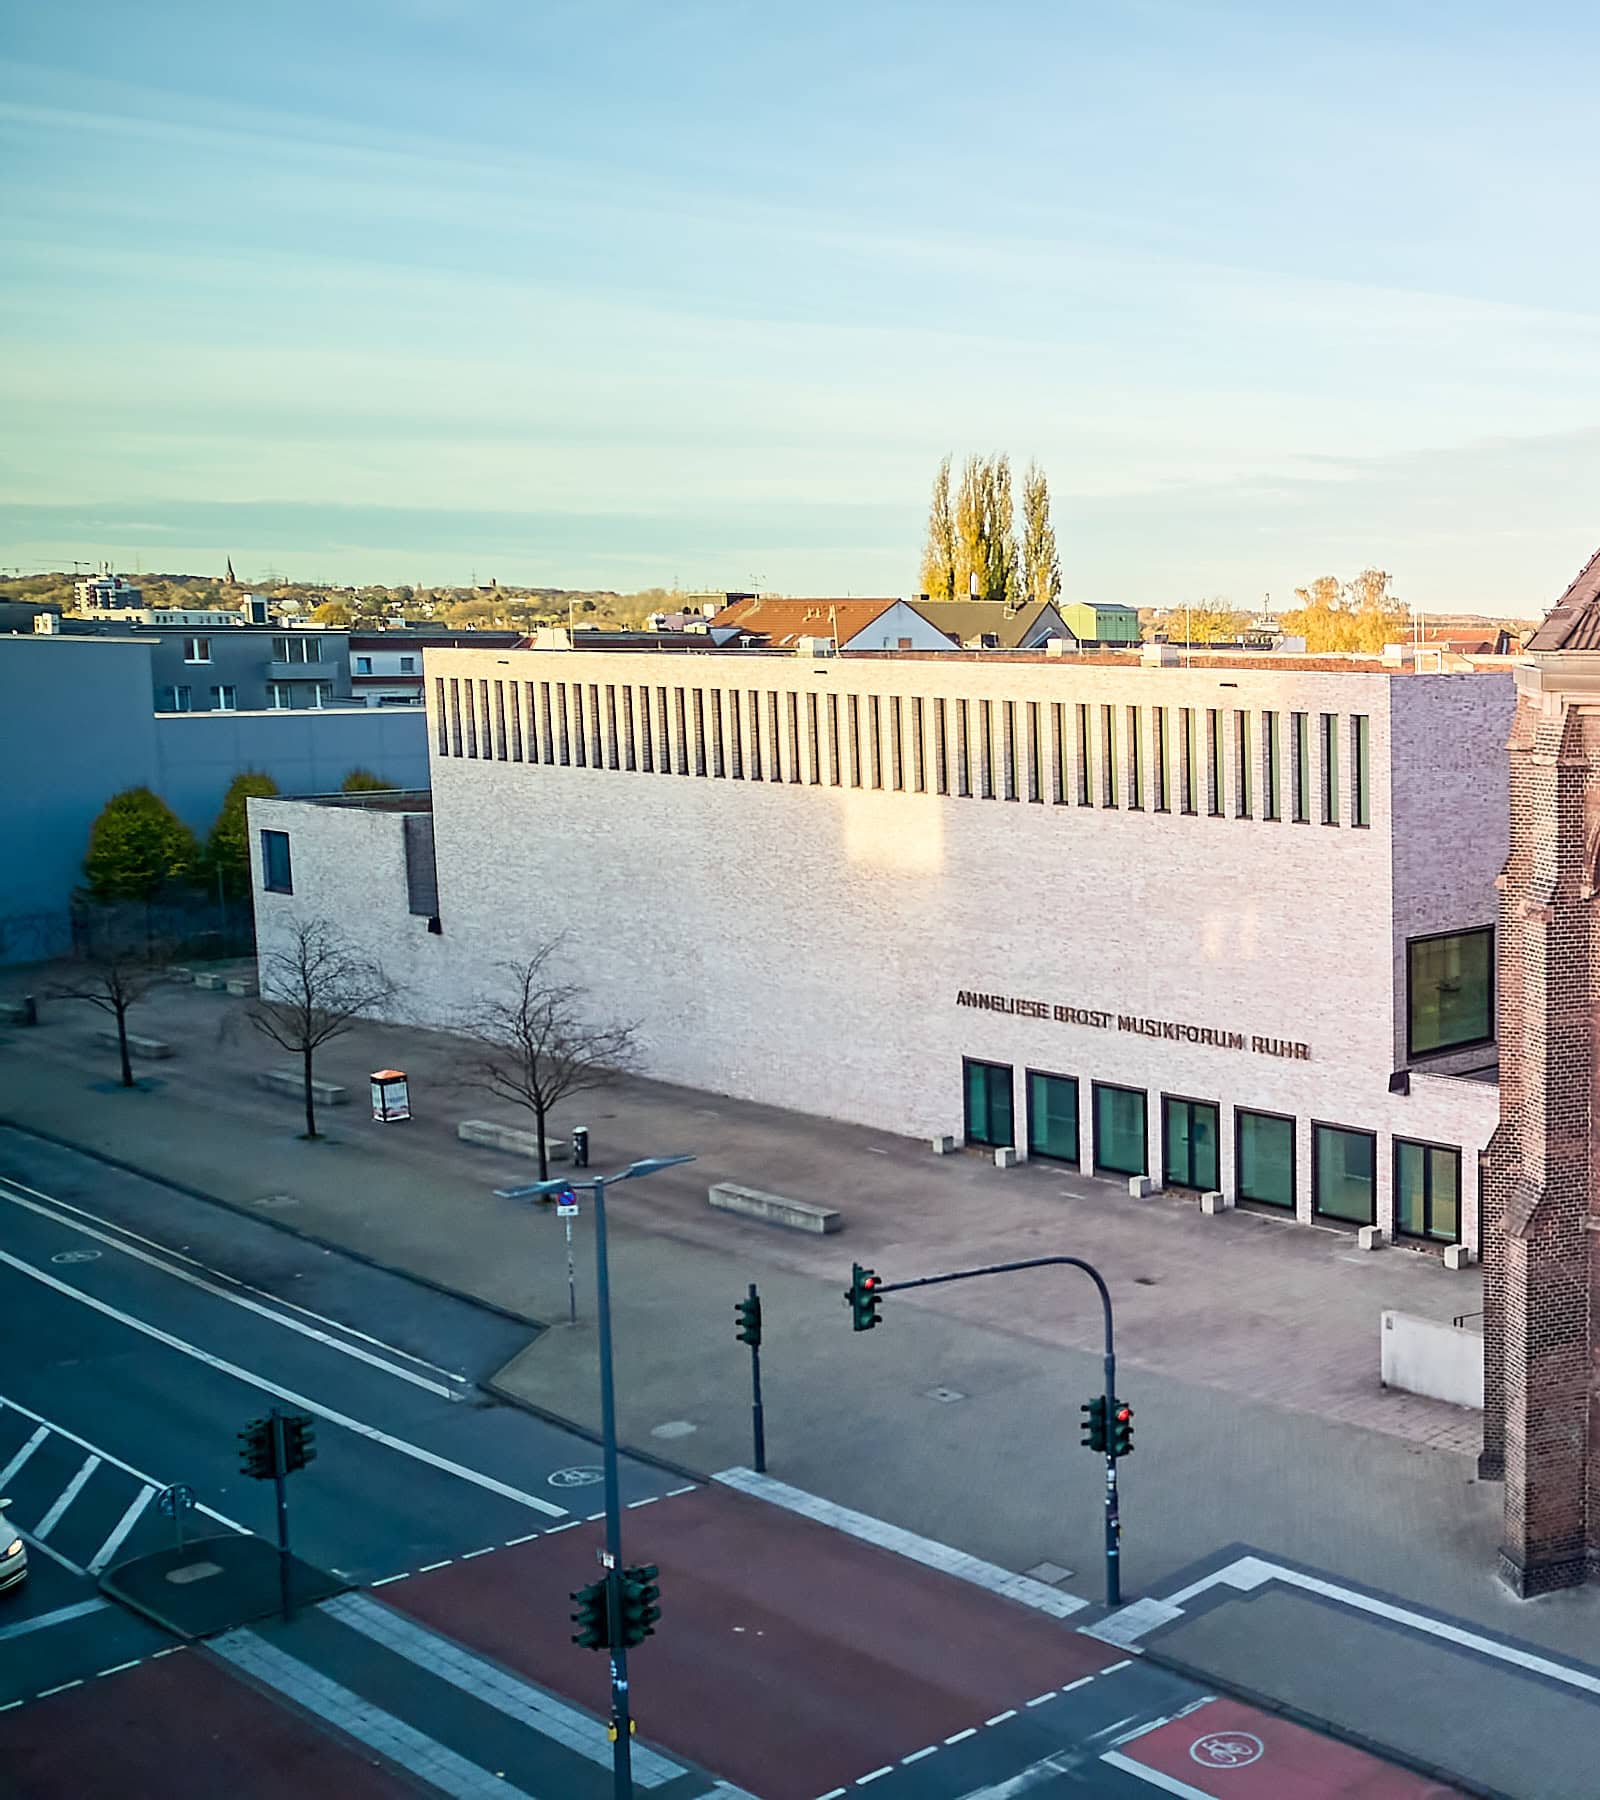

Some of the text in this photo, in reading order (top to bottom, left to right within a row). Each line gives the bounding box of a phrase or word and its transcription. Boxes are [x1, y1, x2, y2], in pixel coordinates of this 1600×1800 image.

[956, 990, 1311, 1060] ANNELIESE BROST MUSIKFORUM RUHR
